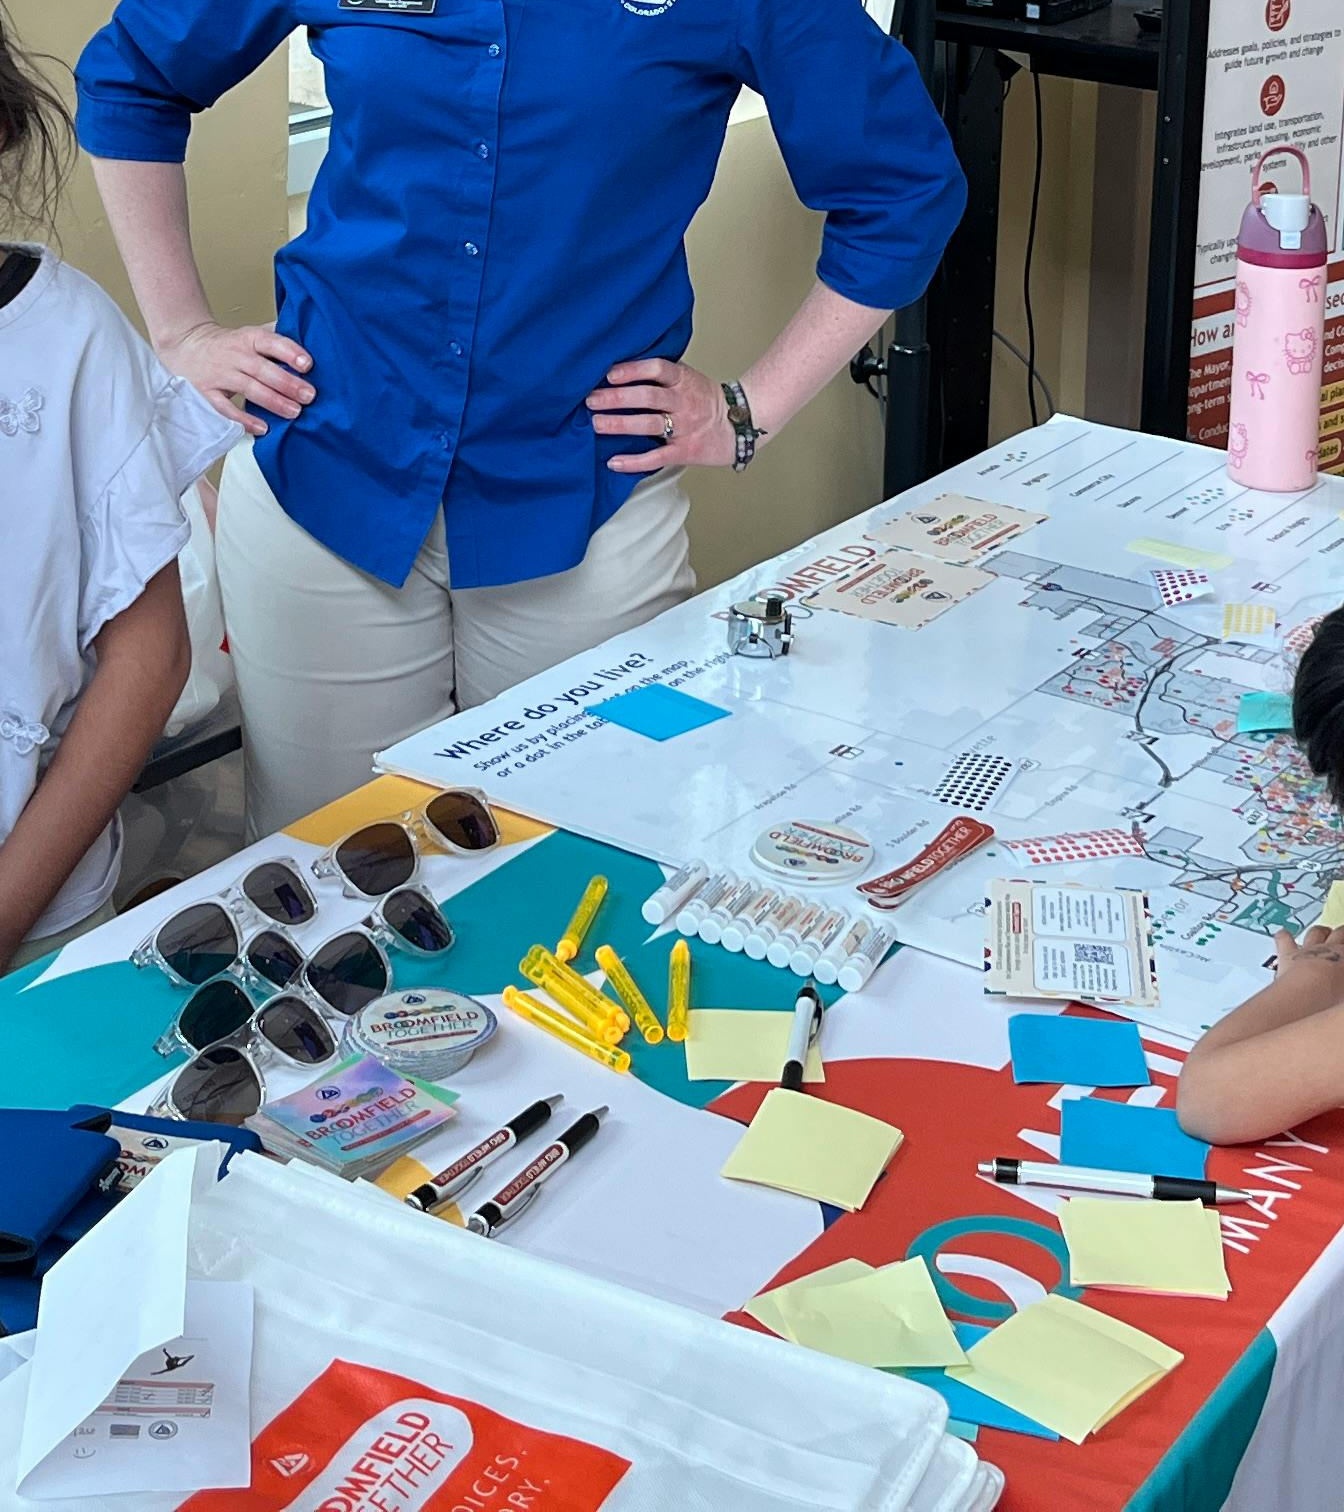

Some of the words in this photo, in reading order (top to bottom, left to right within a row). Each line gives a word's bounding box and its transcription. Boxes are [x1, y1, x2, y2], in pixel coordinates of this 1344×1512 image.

[433, 718, 525, 761] Where
[524, 702, 558, 721] do
[556, 679, 603, 706] you
[595, 652, 654, 681] live?
[474, 750, 510, 772] Show
[511, 740, 529, 753] us
[529, 731, 548, 747] by
[641, 674, 659, 686] the
[496, 766, 512, 778] or
[515, 761, 526, 769] a
[526, 748, 552, 763] dot
[546, 739, 561, 751] in
[561, 728, 587, 744] the
[668, 678, 684, 688] on
[685, 667, 704, 681] the
[370, 1010, 480, 1034] BROOMFIELD
[305, 1088, 416, 1140] BROOMFIELD
[1221, 1124, 1329, 1254] MANY
